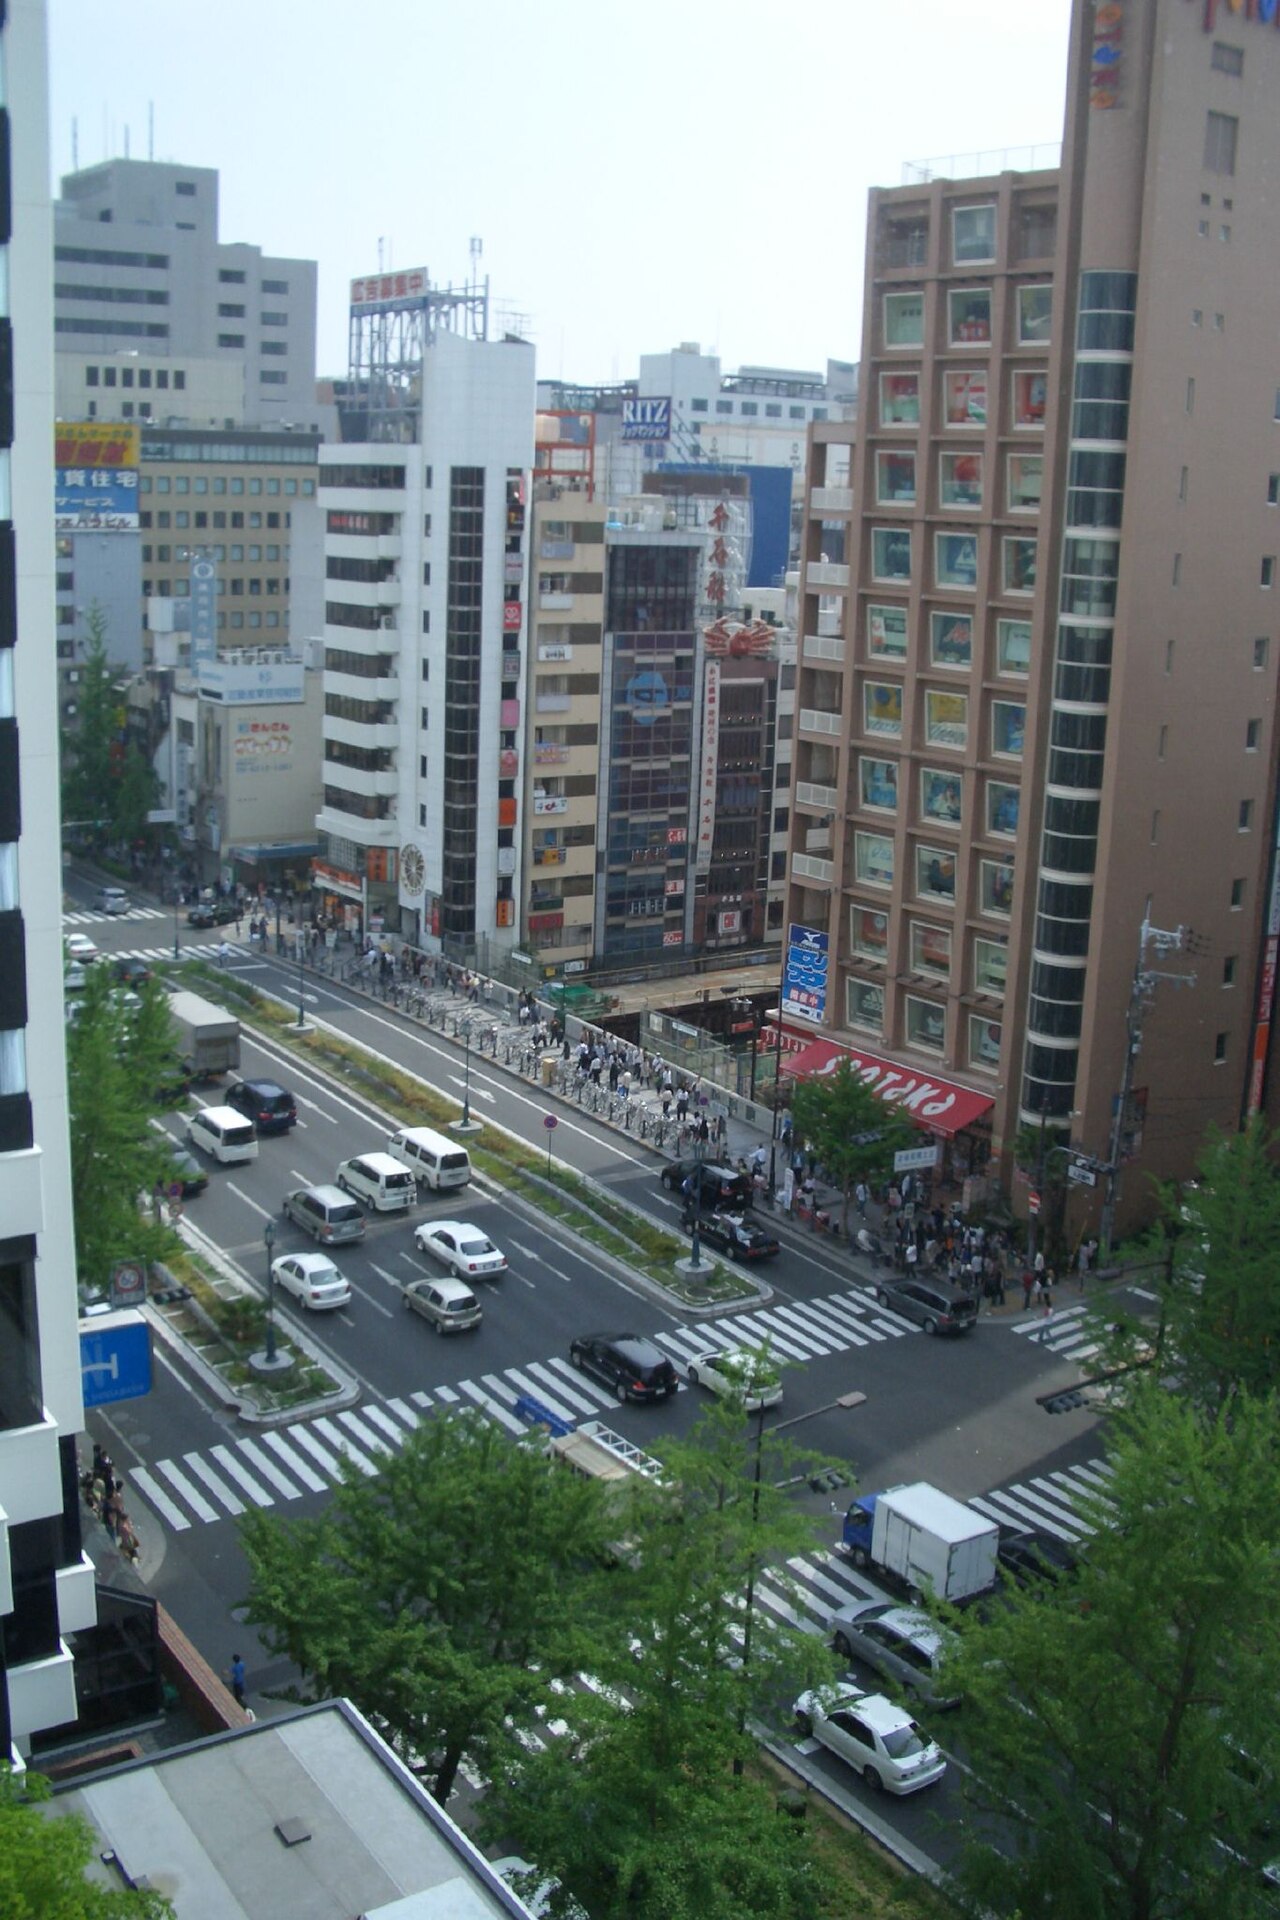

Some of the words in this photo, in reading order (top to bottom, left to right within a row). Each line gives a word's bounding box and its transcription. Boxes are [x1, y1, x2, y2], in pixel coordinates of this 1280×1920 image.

[352, 272, 422, 302] 広告募集中
[623, 400, 668, 423] RITZ
[55, 470, 138, 487] 貸住宅
[789, 987, 819, 1009] 開催中
